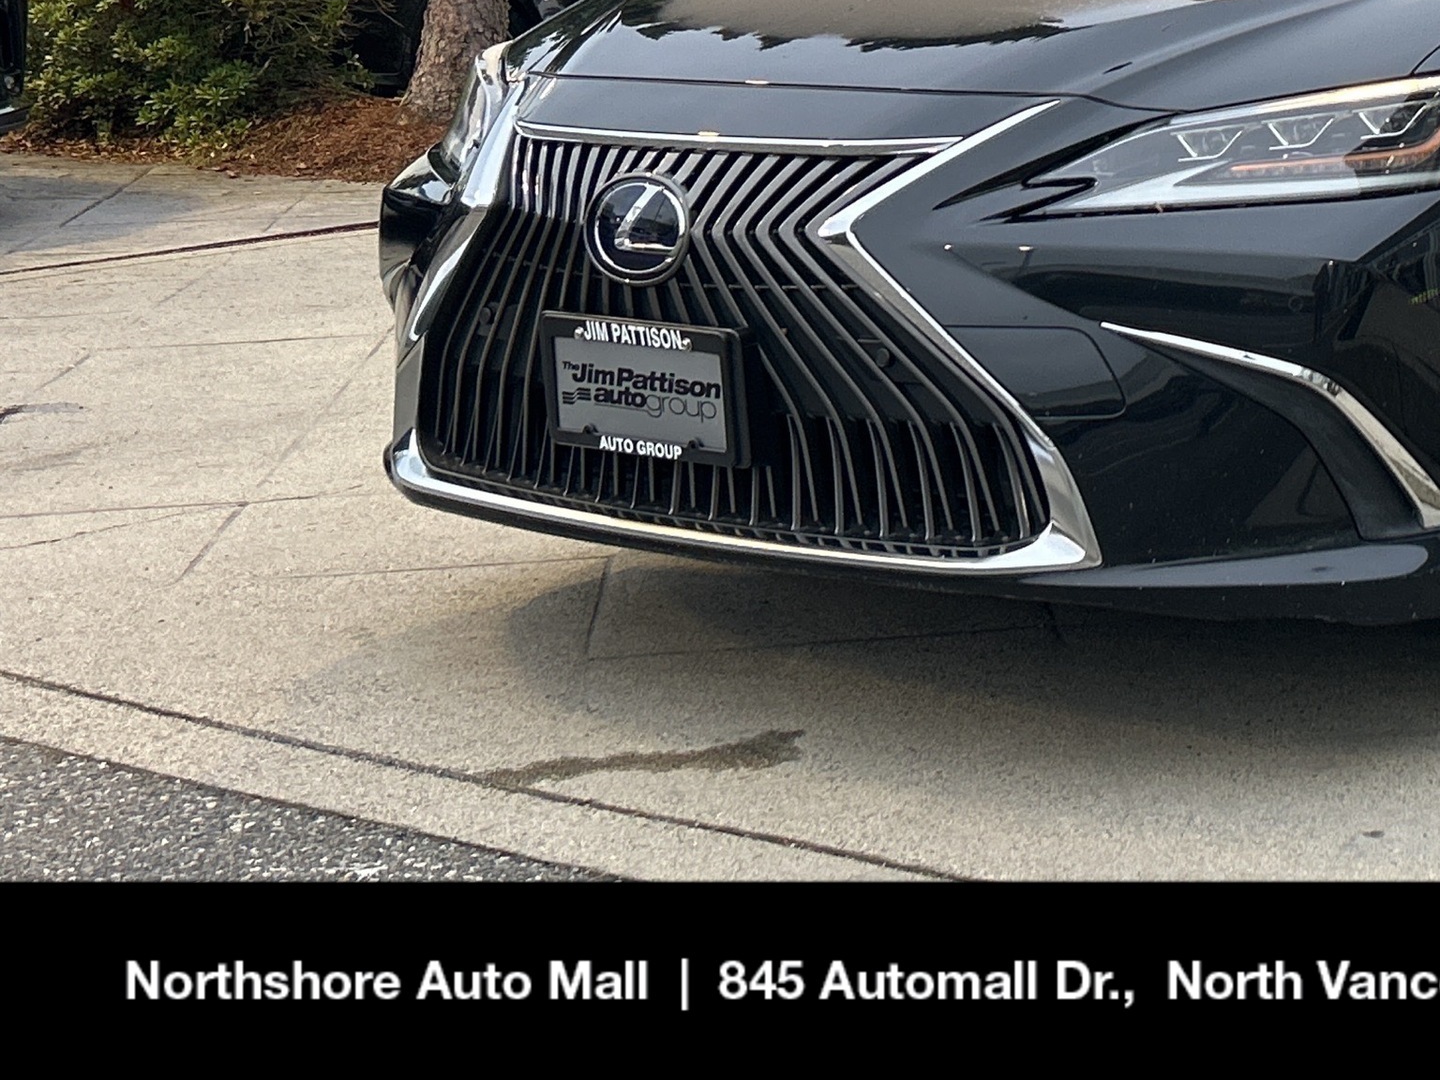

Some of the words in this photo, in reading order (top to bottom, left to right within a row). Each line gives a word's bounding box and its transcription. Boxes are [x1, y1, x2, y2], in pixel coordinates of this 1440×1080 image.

[583, 320, 609, 342] JIM
[611, 323, 683, 350] PATTISON
[562, 361, 580, 371] The
[600, 435, 633, 453] AUTO
[636, 441, 682, 460] GROUP
